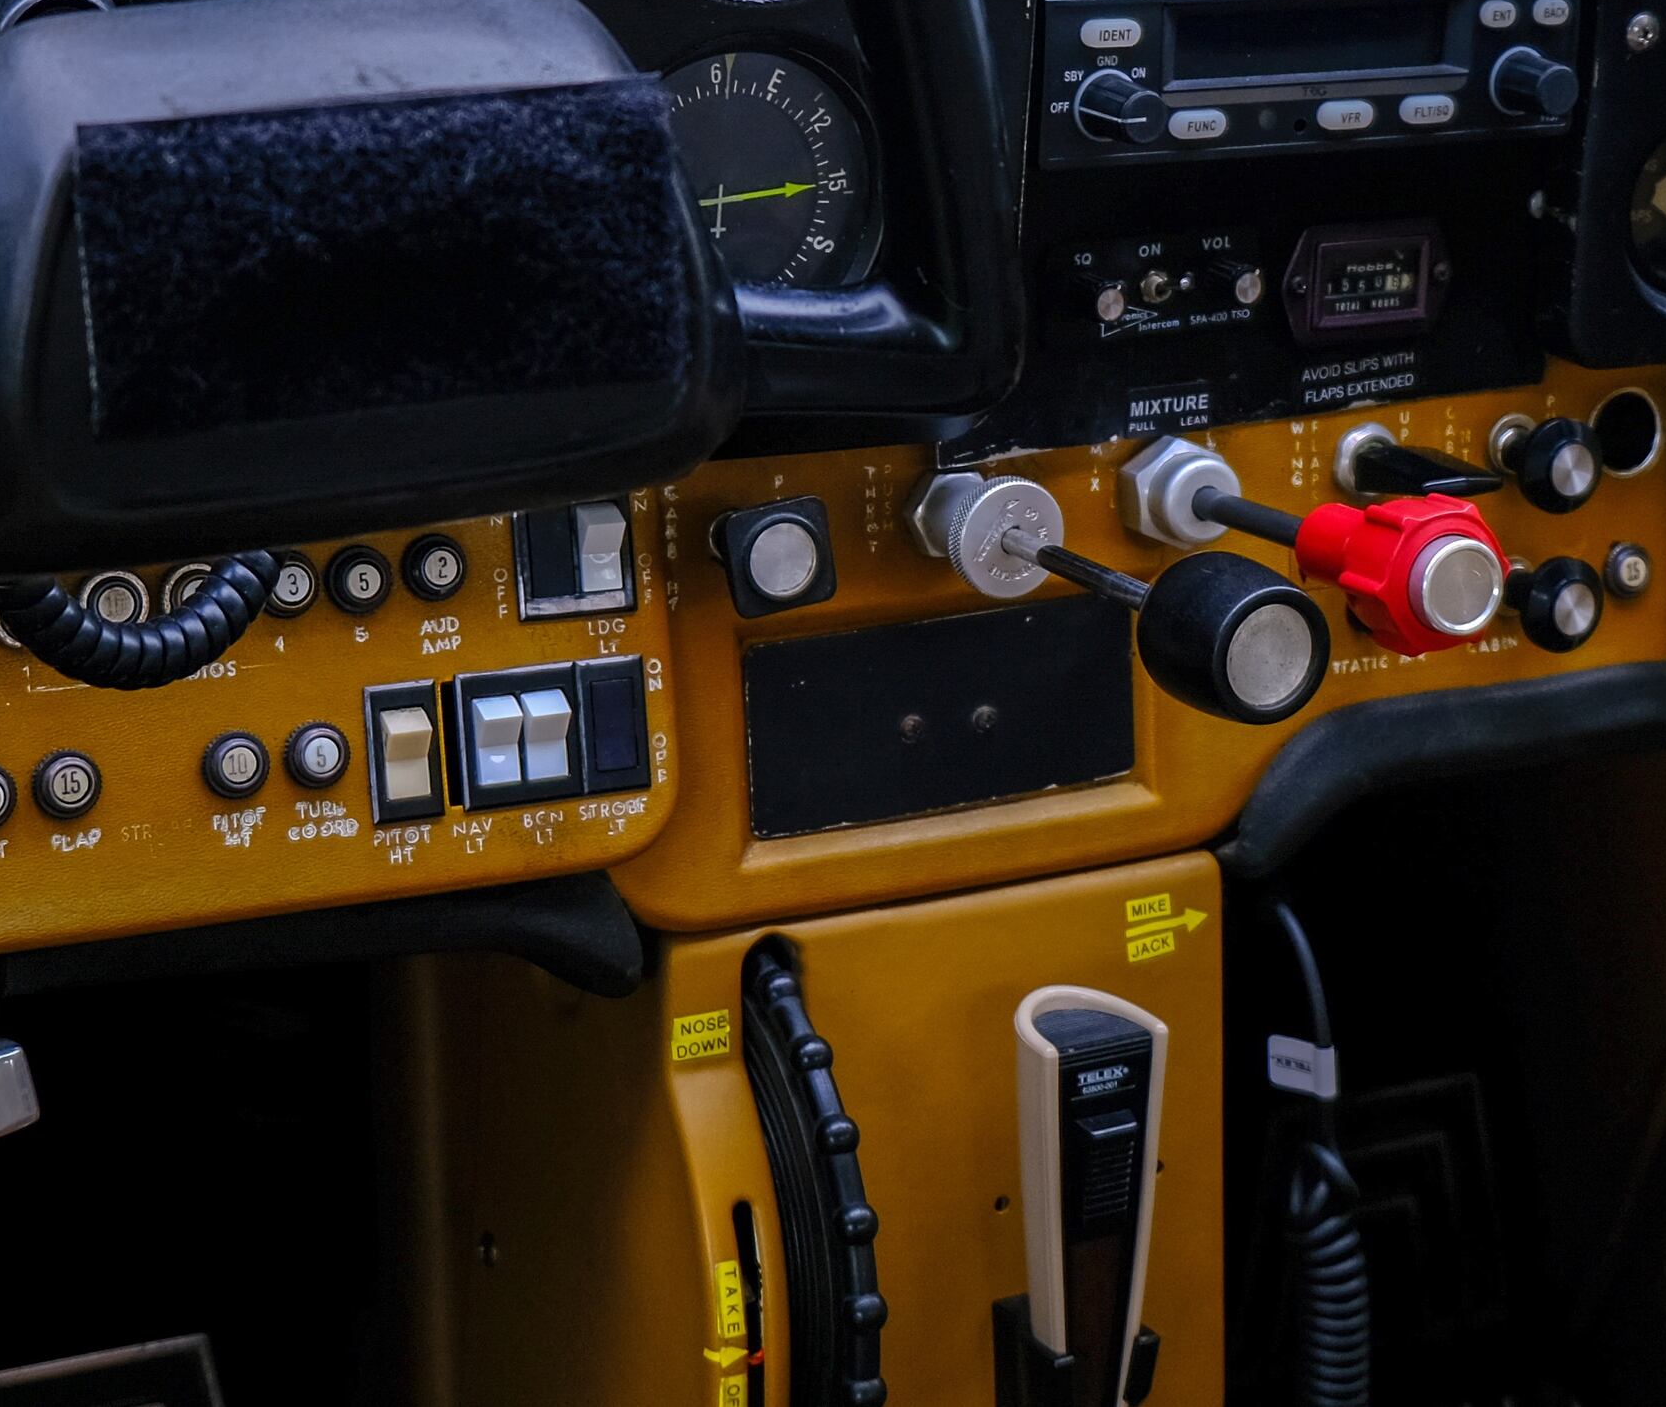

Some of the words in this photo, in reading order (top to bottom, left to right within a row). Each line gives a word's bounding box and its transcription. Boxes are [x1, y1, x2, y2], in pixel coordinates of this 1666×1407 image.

[1492, 10, 1511, 21] ENT
[1544, 8, 1567, 19] BACK
[1099, 29, 1132, 42] IDENT
[1097, 55, 1118, 67] GND
[1064, 71, 1084, 82] SBY
[1131, 68, 1146, 78] ON
[1050, 102, 1069, 113] OFF
[1188, 120, 1216, 131] FUNC
[1341, 112, 1361, 123] VFR
[1138, 242, 1161, 257] ON
[1202, 236, 1231, 250] VOL
[1074, 253, 1092, 265] SQ
[1231, 309, 1250, 319] TSO
[1335, 301, 1360, 311] TOTAL
[1138, 319, 1180, 332] Intercom
[1302, 364, 1341, 382] AVOID
[1344, 357, 1379, 375] SLIPS
[1383, 351, 1415, 367] WITH
[1305, 386, 1344, 404] FLAPS
[1347, 374, 1414, 395] EXTENDED
[1130, 393, 1209, 418] MIXTURE
[1129, 421, 1156, 433] PULL
[1180, 414, 1209, 427] LEAN
[588, 617, 626, 635] LDG
[453, 817, 493, 837] NAV
[522, 809, 565, 829] BCN
[287, 817, 360, 842] COORD
[373, 824, 434, 849] PITOT
[1131, 897, 1168, 917] MIKE
[1131, 935, 1171, 958] JACK
[681, 1015, 727, 1037] NOSE
[676, 1036, 728, 1057] DOWN
[1078, 1066, 1123, 1085] TELEX
[725, 1268, 739, 1333] TAKE
